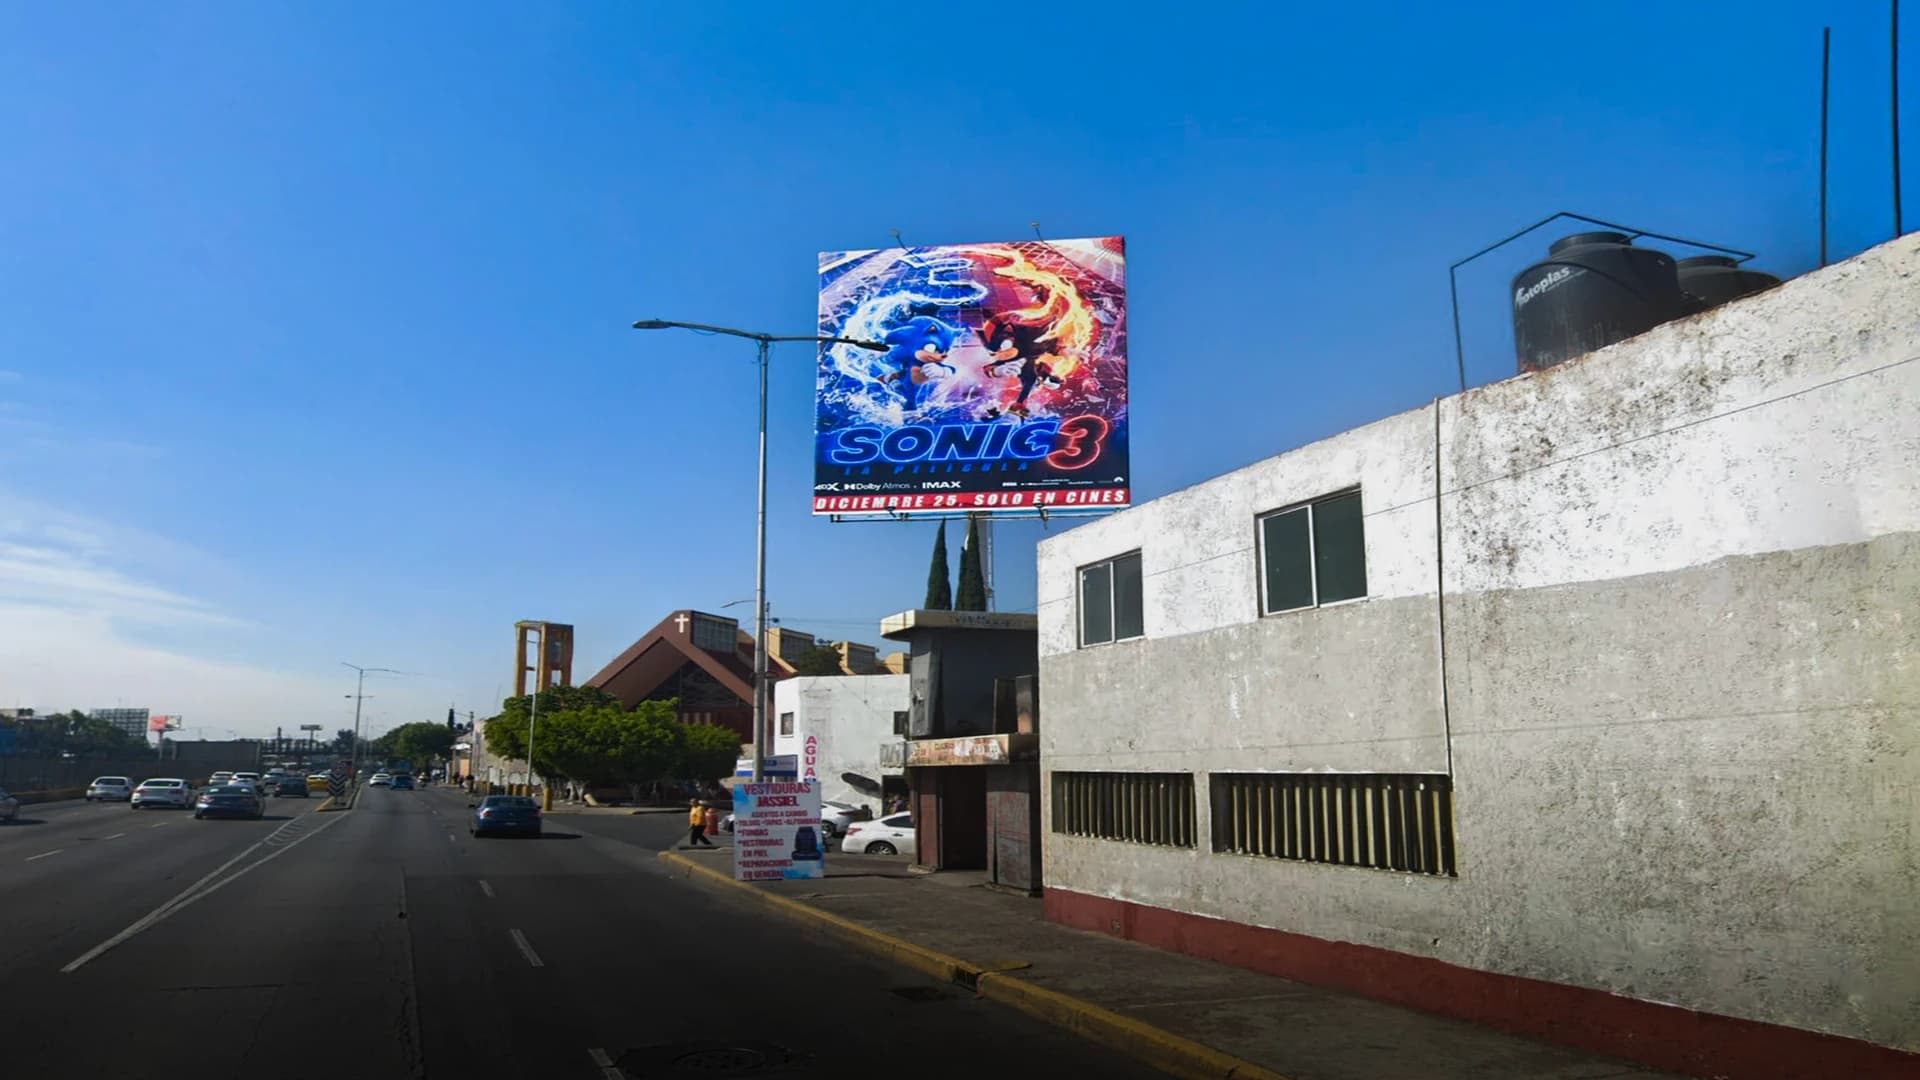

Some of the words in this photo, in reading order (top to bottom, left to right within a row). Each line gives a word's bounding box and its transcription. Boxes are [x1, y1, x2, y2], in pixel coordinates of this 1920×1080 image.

[831, 421, 1059, 464] SONIC
[1047, 414, 1109, 470] 3
[856, 483, 881, 491] Dolby
[882, 482, 911, 490] Atmos
[922, 481, 961, 489] IMAX
[816, 495, 924, 509] DICIEMBRE
[974, 493, 1023, 505] SOLO
[1033, 491, 1056, 504] EN
[1066, 490, 1125, 503] CINES
[804, 735, 817, 776] AGUA
[744, 782, 811, 795] VESTIDURAS
